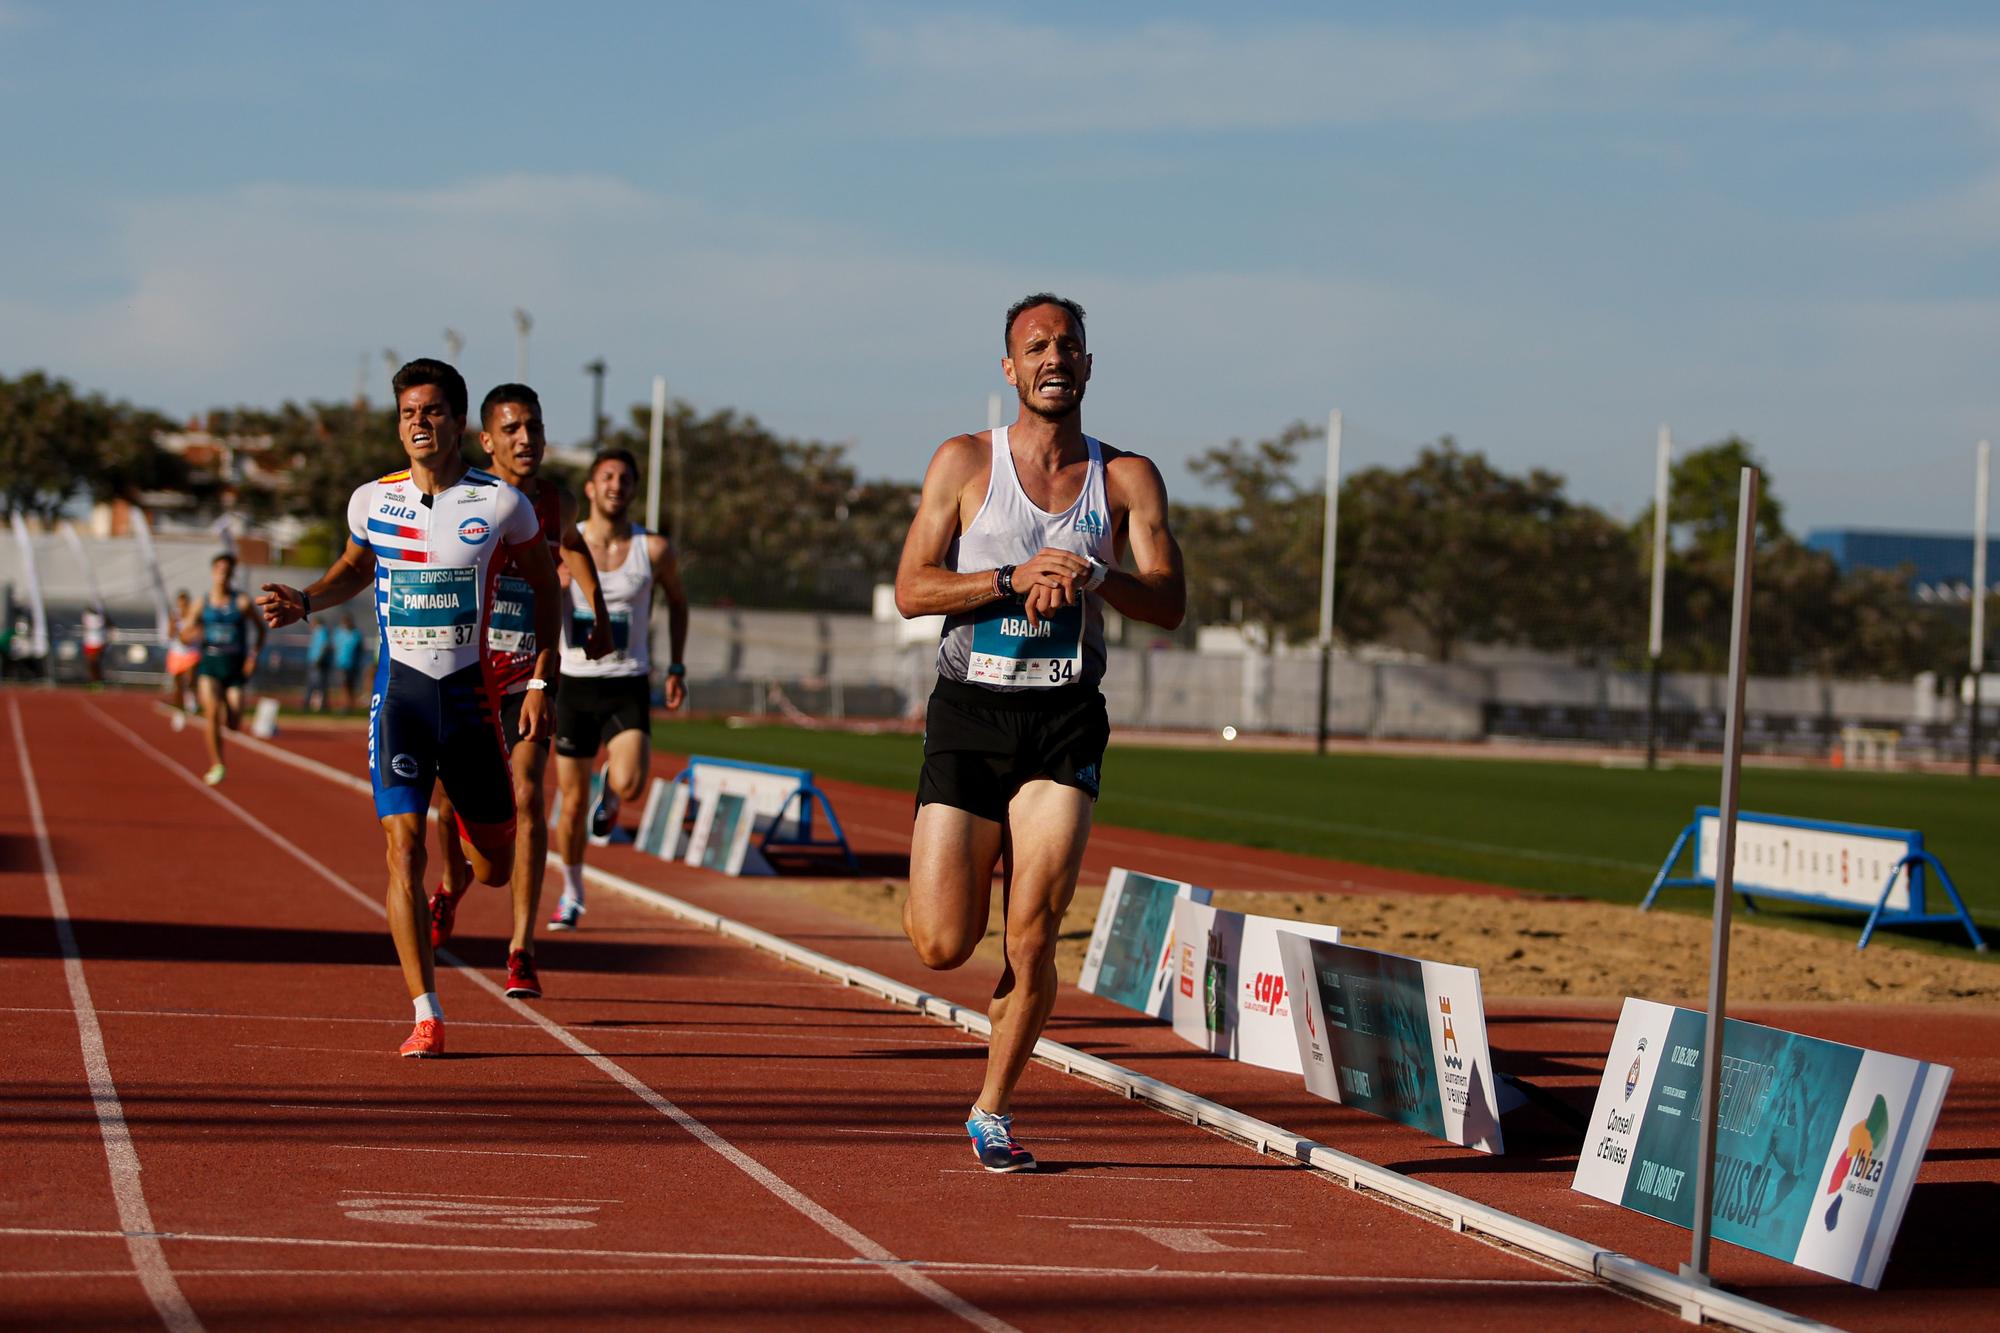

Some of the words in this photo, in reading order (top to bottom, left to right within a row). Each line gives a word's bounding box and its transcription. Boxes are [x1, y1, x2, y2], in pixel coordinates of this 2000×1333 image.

[379, 503, 417, 520] aula
[420, 571, 454, 584] EIVISSA
[403, 594, 460, 609] PANIAGUA
[494, 601, 522, 616] ORTIZ
[455, 625, 473, 645] 37
[518, 634, 535, 651] 40
[1049, 660, 1074, 682] 34
[1607, 1108, 1636, 1136] Consell
[1597, 1135, 1628, 1166] d'Eivissa
[1850, 1147, 1884, 1183] Ibiza
[1635, 1160, 1658, 1194] TONI
[1652, 1165, 1686, 1202] BONET
